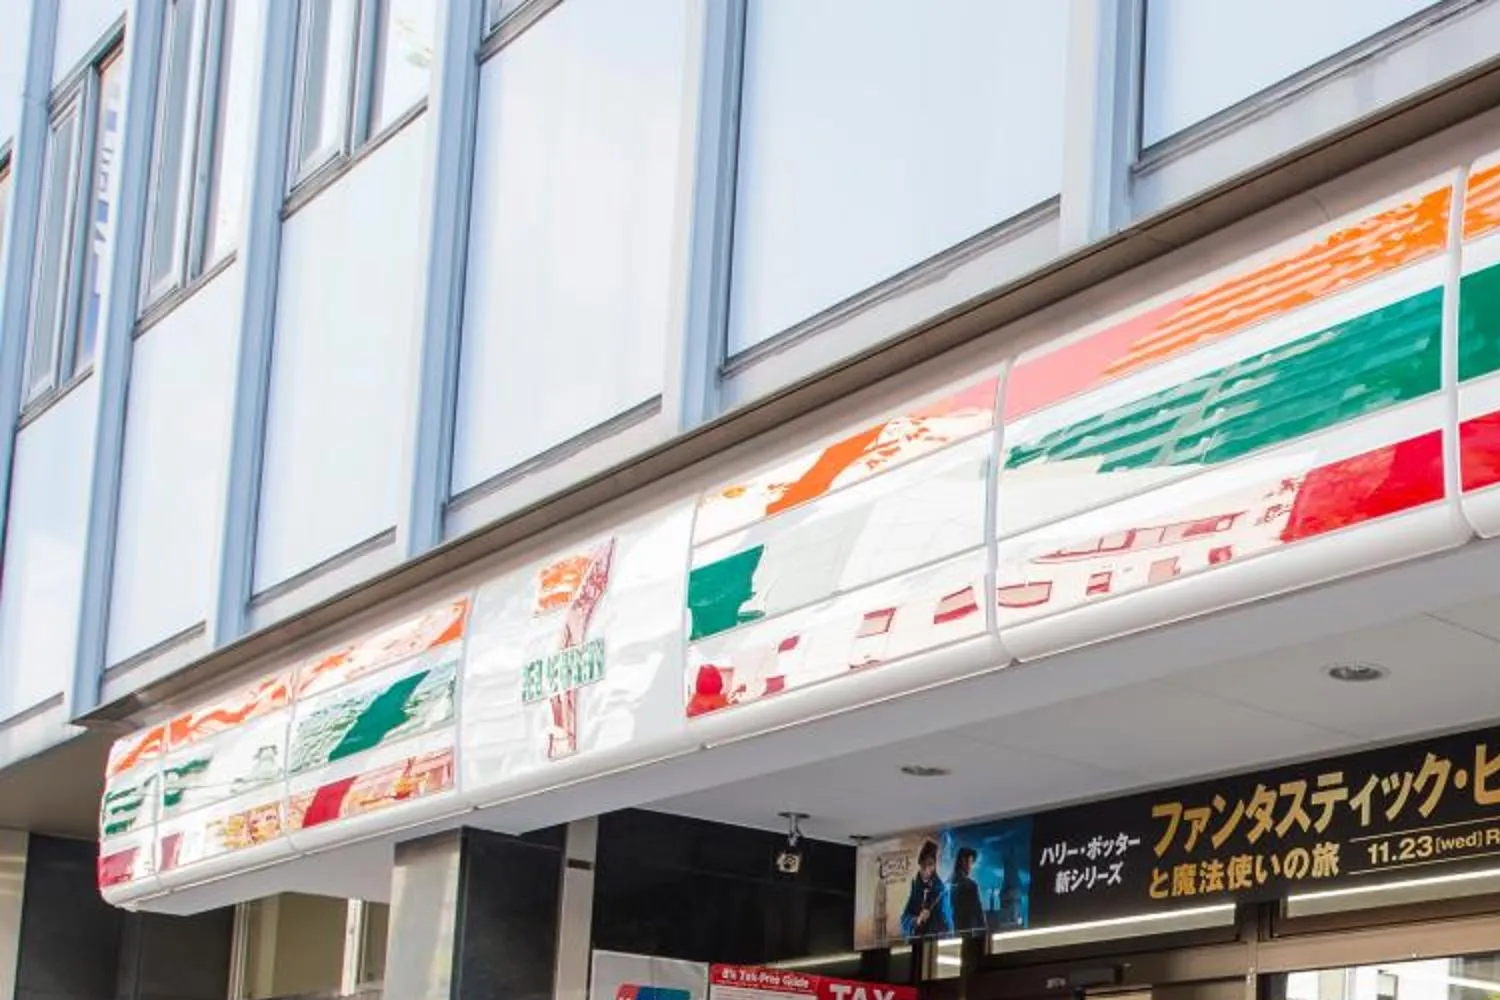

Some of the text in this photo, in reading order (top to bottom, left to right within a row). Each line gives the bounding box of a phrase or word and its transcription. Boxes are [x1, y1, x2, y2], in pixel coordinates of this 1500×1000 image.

[1040, 833, 1141, 866] ハリー・ポッター
[1055, 860, 1123, 894] 新シリーズ
[1148, 842, 1341, 899] と魔法使いの旅
